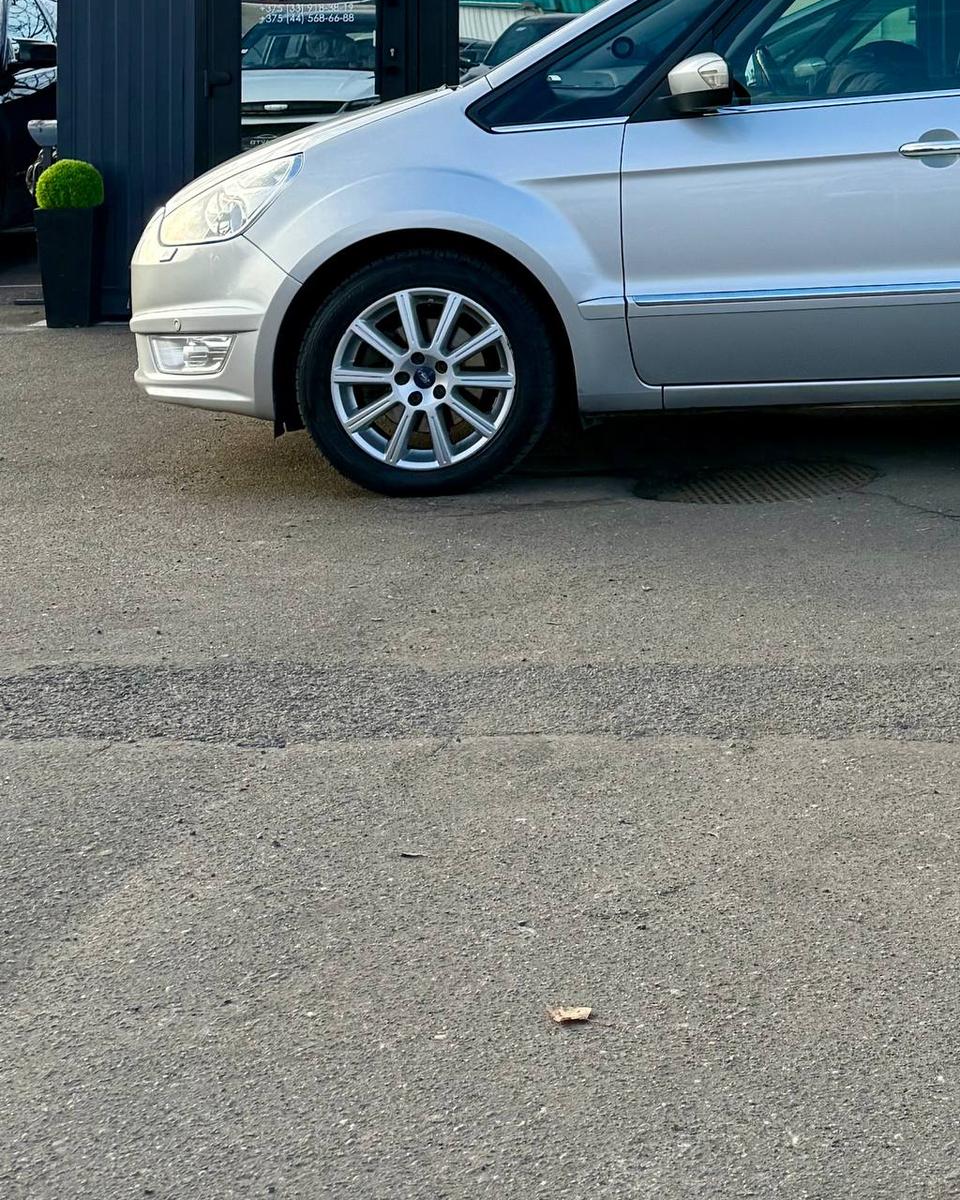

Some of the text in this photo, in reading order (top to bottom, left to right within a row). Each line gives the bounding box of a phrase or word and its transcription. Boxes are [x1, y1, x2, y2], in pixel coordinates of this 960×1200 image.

[259, 13, 355, 24] +375 (44) 568-66-88
